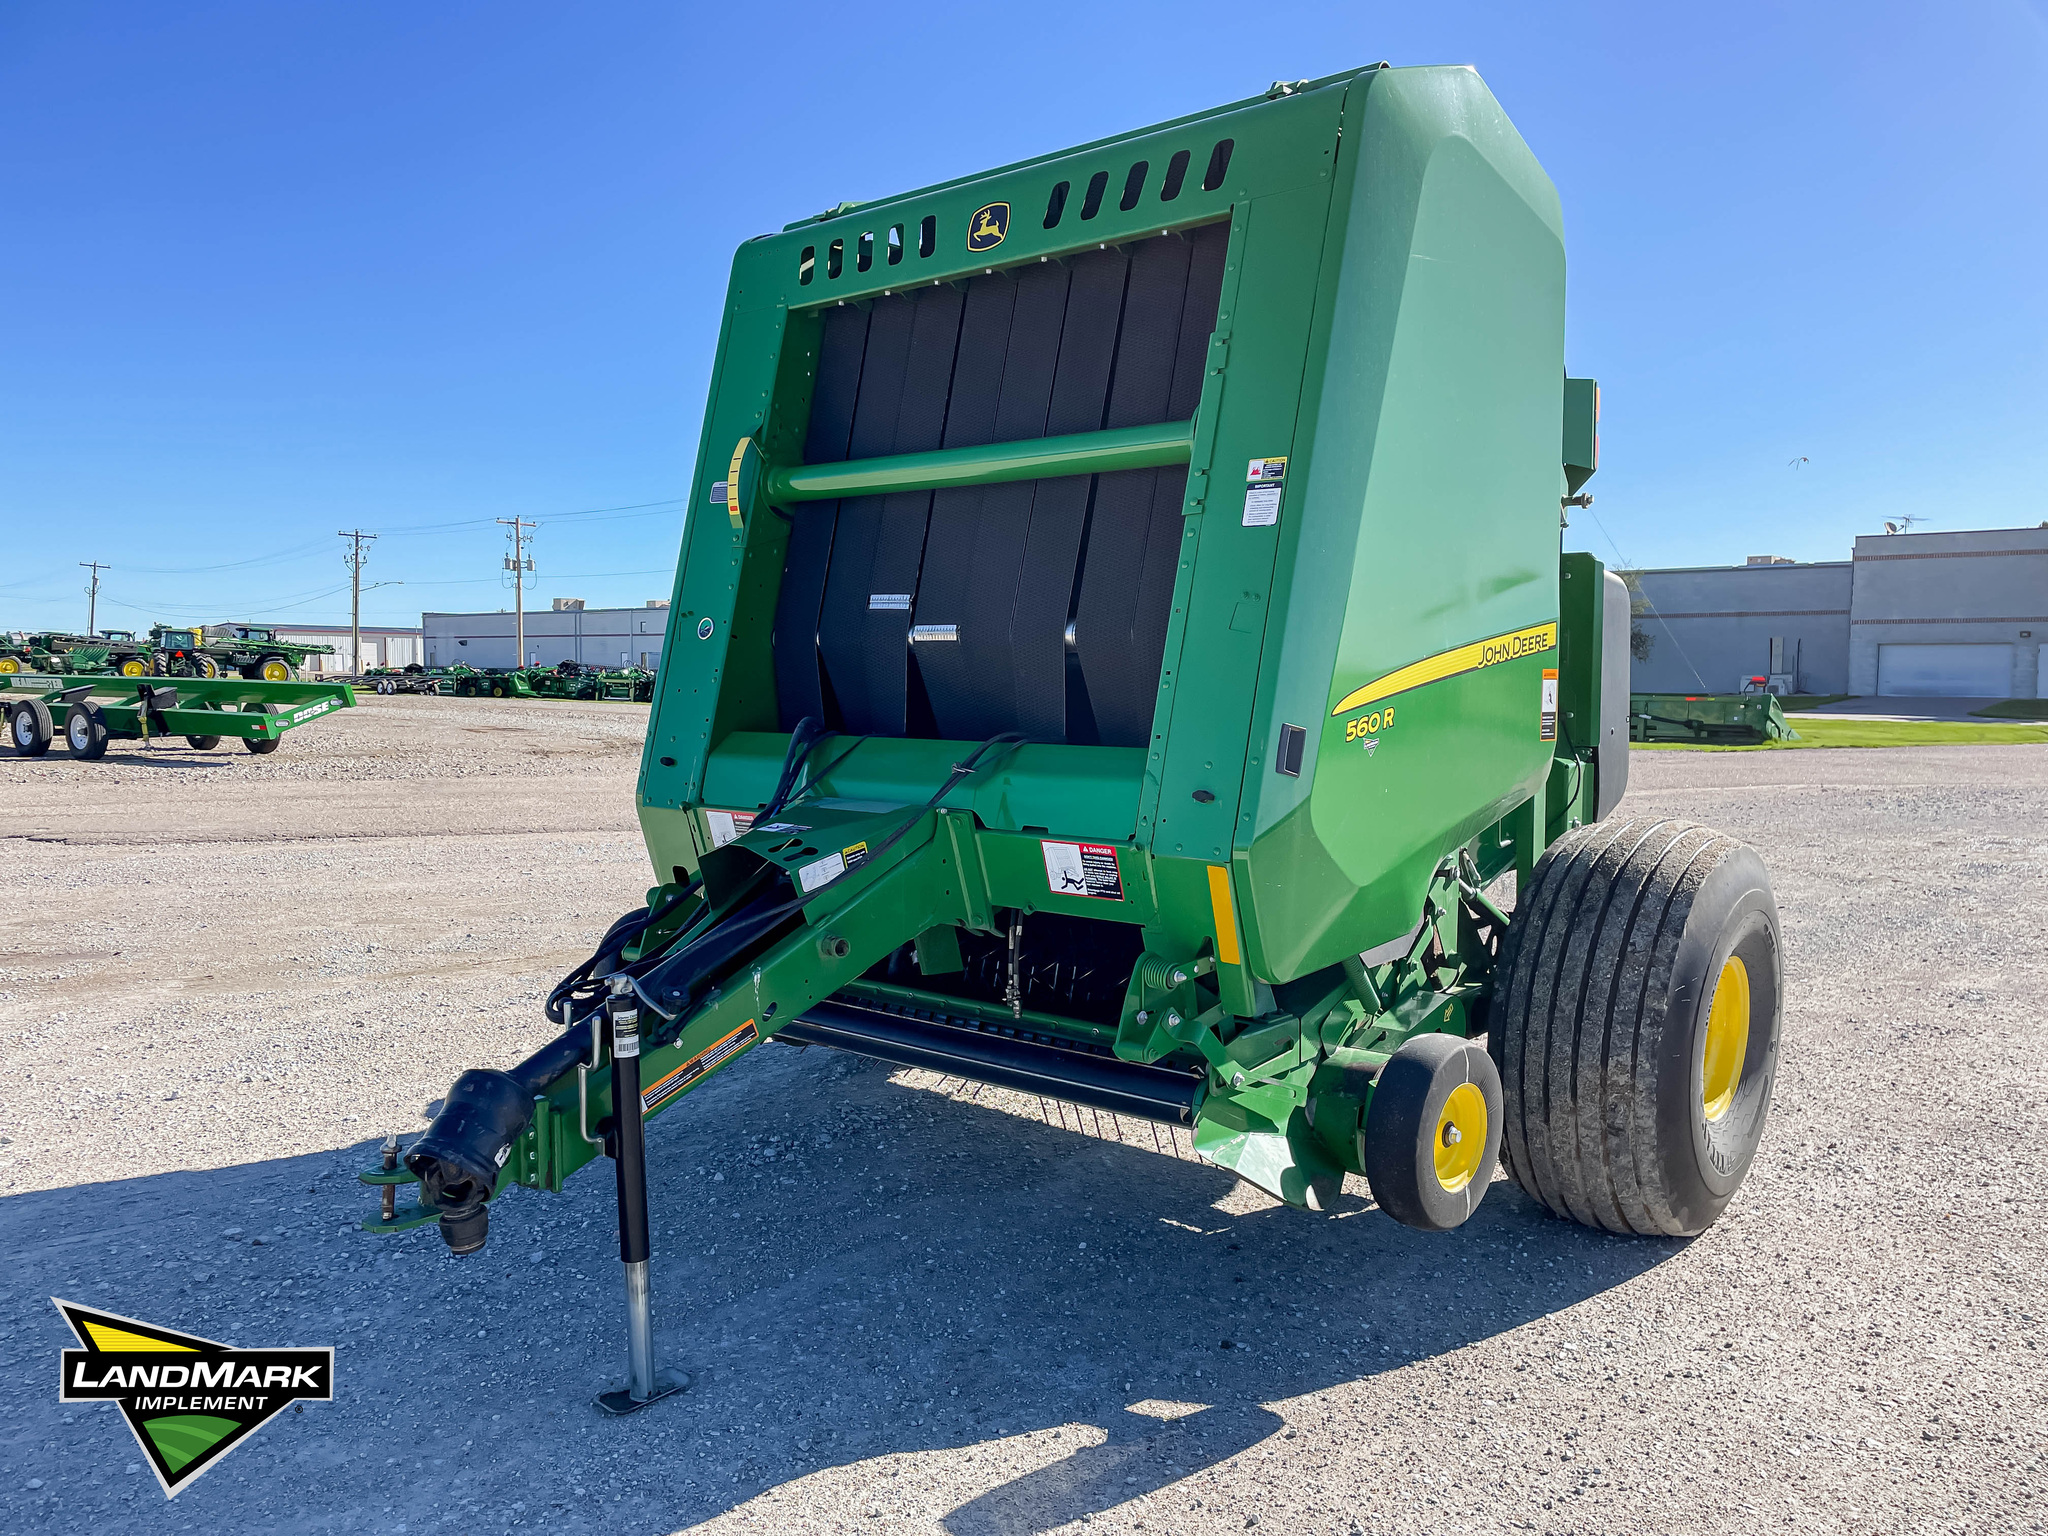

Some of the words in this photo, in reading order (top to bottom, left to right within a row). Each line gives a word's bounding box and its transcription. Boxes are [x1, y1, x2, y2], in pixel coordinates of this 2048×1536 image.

[1477, 640, 1511, 666] JOHN
[1512, 632, 1549, 656] DEERE
[1345, 717, 1381, 743] 560
[1382, 706, 1396, 730] R
[1088, 846, 1112, 855] DANGER
